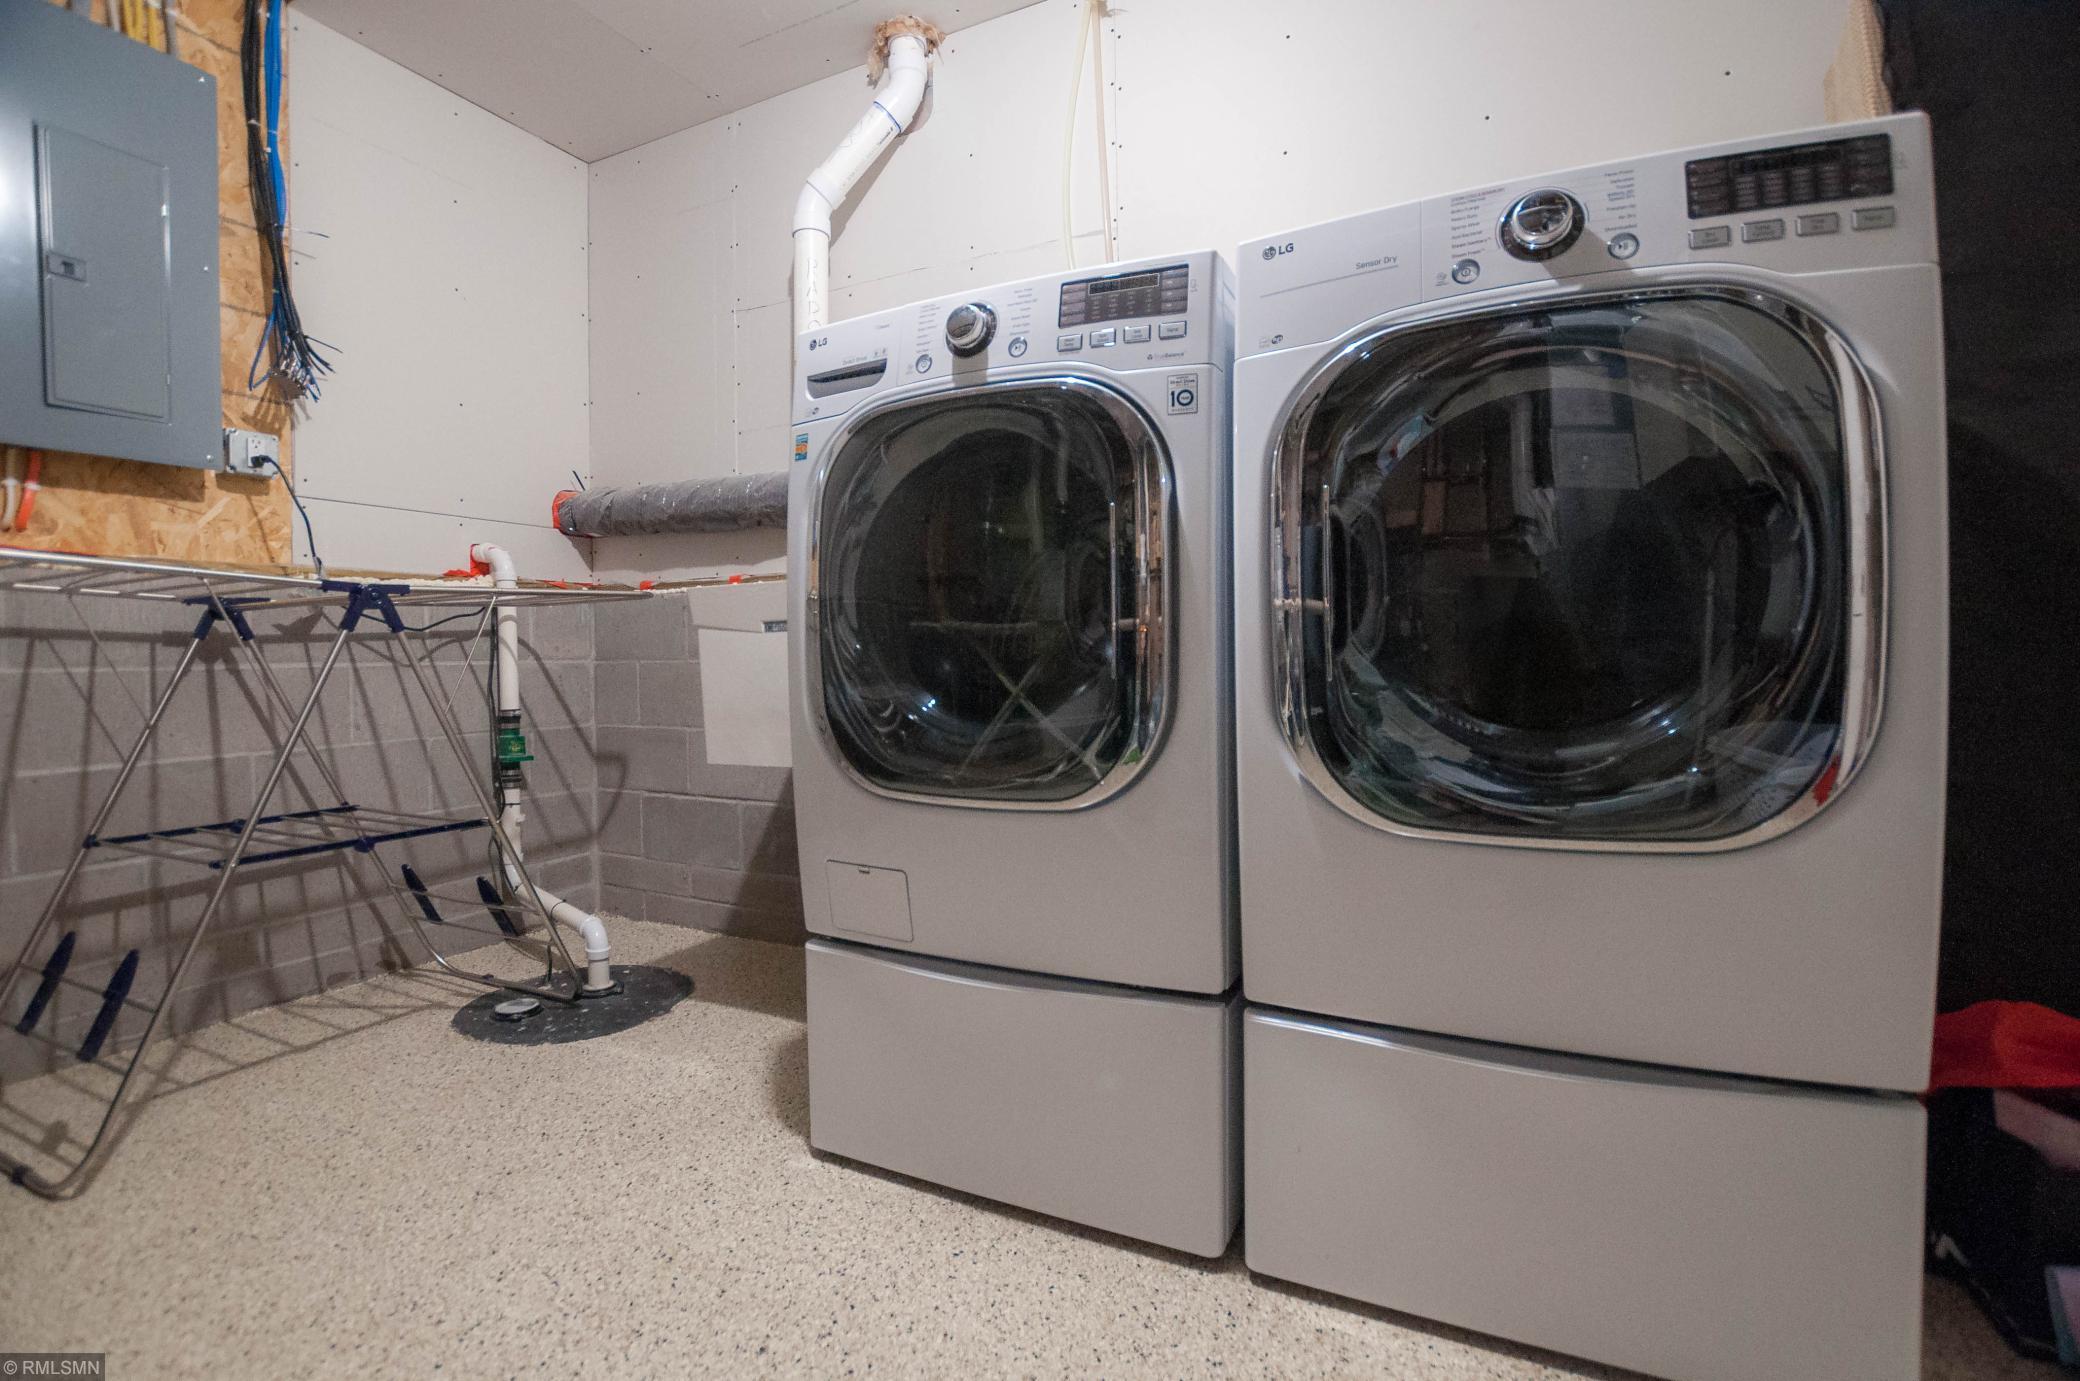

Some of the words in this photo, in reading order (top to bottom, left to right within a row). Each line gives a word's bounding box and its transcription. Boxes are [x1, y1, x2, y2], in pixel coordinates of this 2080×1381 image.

[1277, 243, 1295, 255] LG
[1355, 258, 1382, 270] Sensor
[1383, 255, 1398, 265] Dry
[1170, 389, 1194, 407] 10
